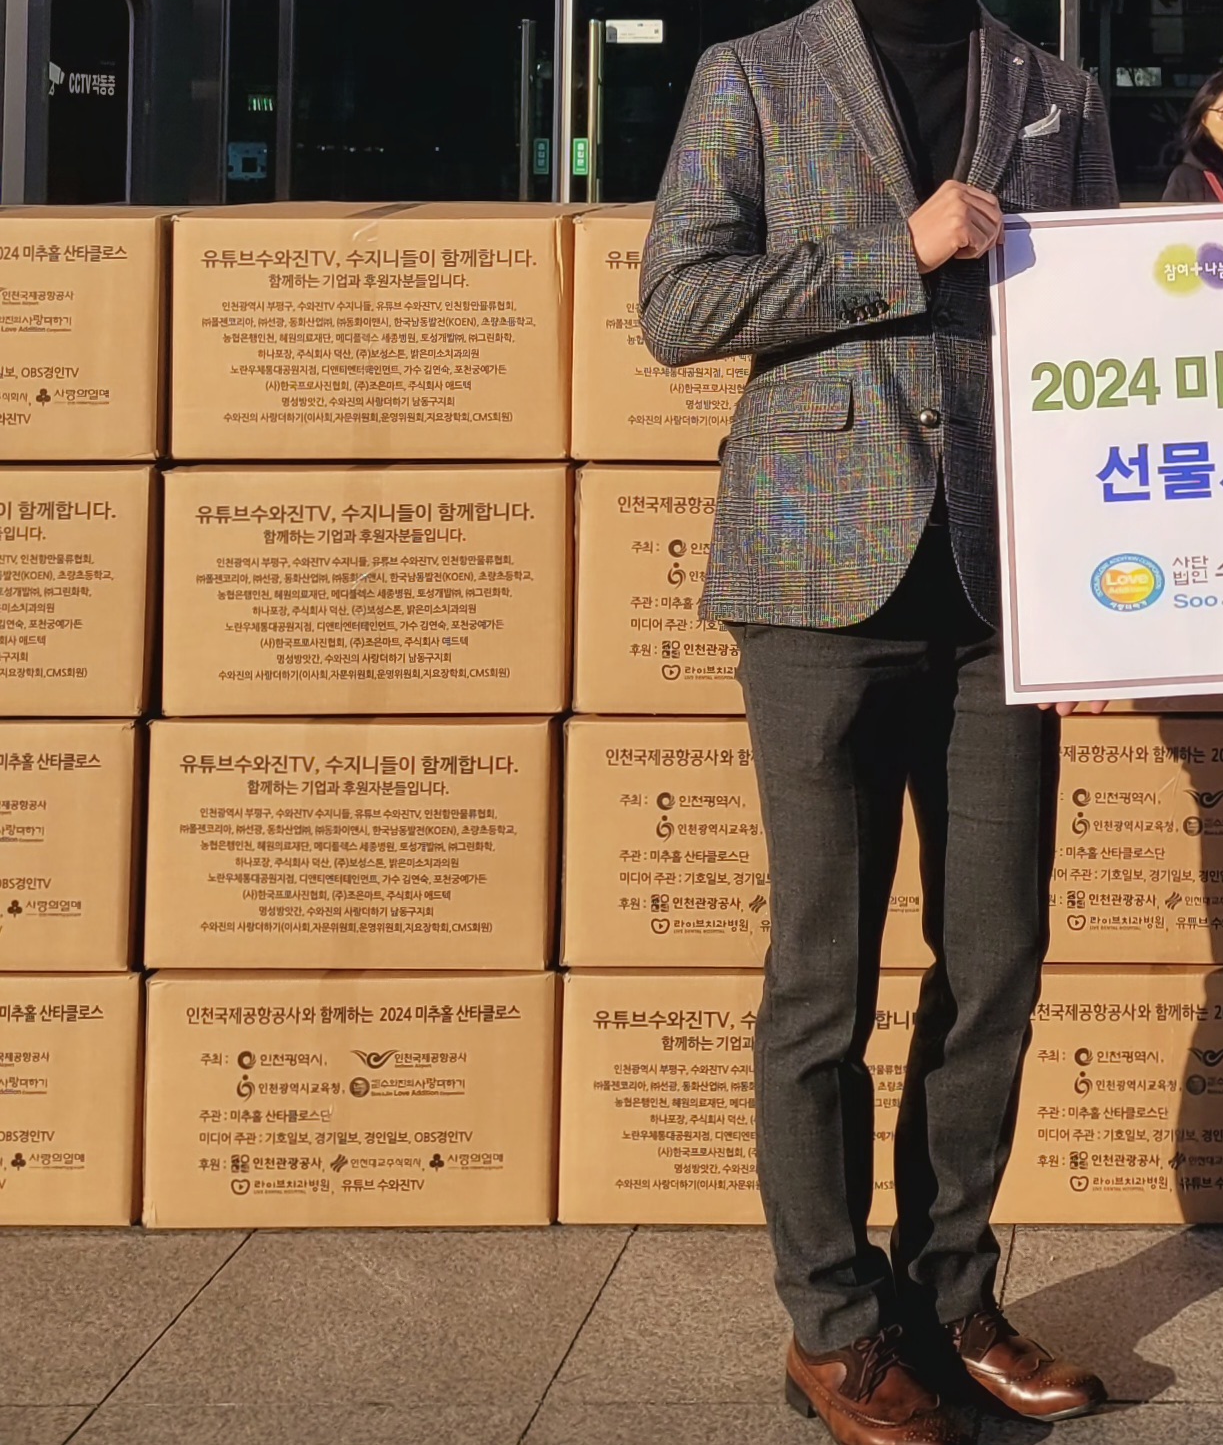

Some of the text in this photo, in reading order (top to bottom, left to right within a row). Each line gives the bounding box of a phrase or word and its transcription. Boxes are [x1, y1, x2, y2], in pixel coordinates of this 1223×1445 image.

[23, 245, 127, 262] 미추홀 산타클로스
[201, 249, 536, 268] 유튜브수와진TV, 수지니들이 함께합니다.
[269, 274, 468, 288] 함께하는 기업과 후원자분들입니다.
[21, 367, 79, 379] OBS경인TV
[1032, 356, 1160, 412] 2024
[18, 501, 116, 520] 함께합니다.
[196, 502, 534, 524] 유튜브수와진TV, 수지니들이 함께합니다.
[264, 528, 466, 544] 함께하는 기업과 후원자분들입니다.
[1173, 556, 1208, 569] 사단
[1173, 570, 1208, 586] 법인
[37, 753, 101, 770] 산타클로스
[606, 749, 734, 767] 인천국제공항공사와
[1154, 747, 1205, 763] 함께하는
[180, 755, 518, 775] 유튜브수와진TV, 수지니들이 함께합니다.
[247, 780, 449, 796] 함께하는 기업과 후원자분들입니다.
[39, 1005, 103, 1022] 산타클로스
[186, 1005, 521, 1025] 인천국제공항공사와 함께하는 2024 미추홀 산타클로스
[593, 1010, 734, 1030] 유튜브수와진TV,
[1155, 1004, 1208, 1021] 함께하는
[662, 1036, 714, 1051] 함께하는
[230, 1110, 263, 1123] 미추홀
[199, 1132, 231, 1145] 미디어
[414, 1131, 473, 1144] OBS경인TV
[341, 1179, 376, 1192] 유튜브
[376, 1179, 424, 1191] 수와진TV
